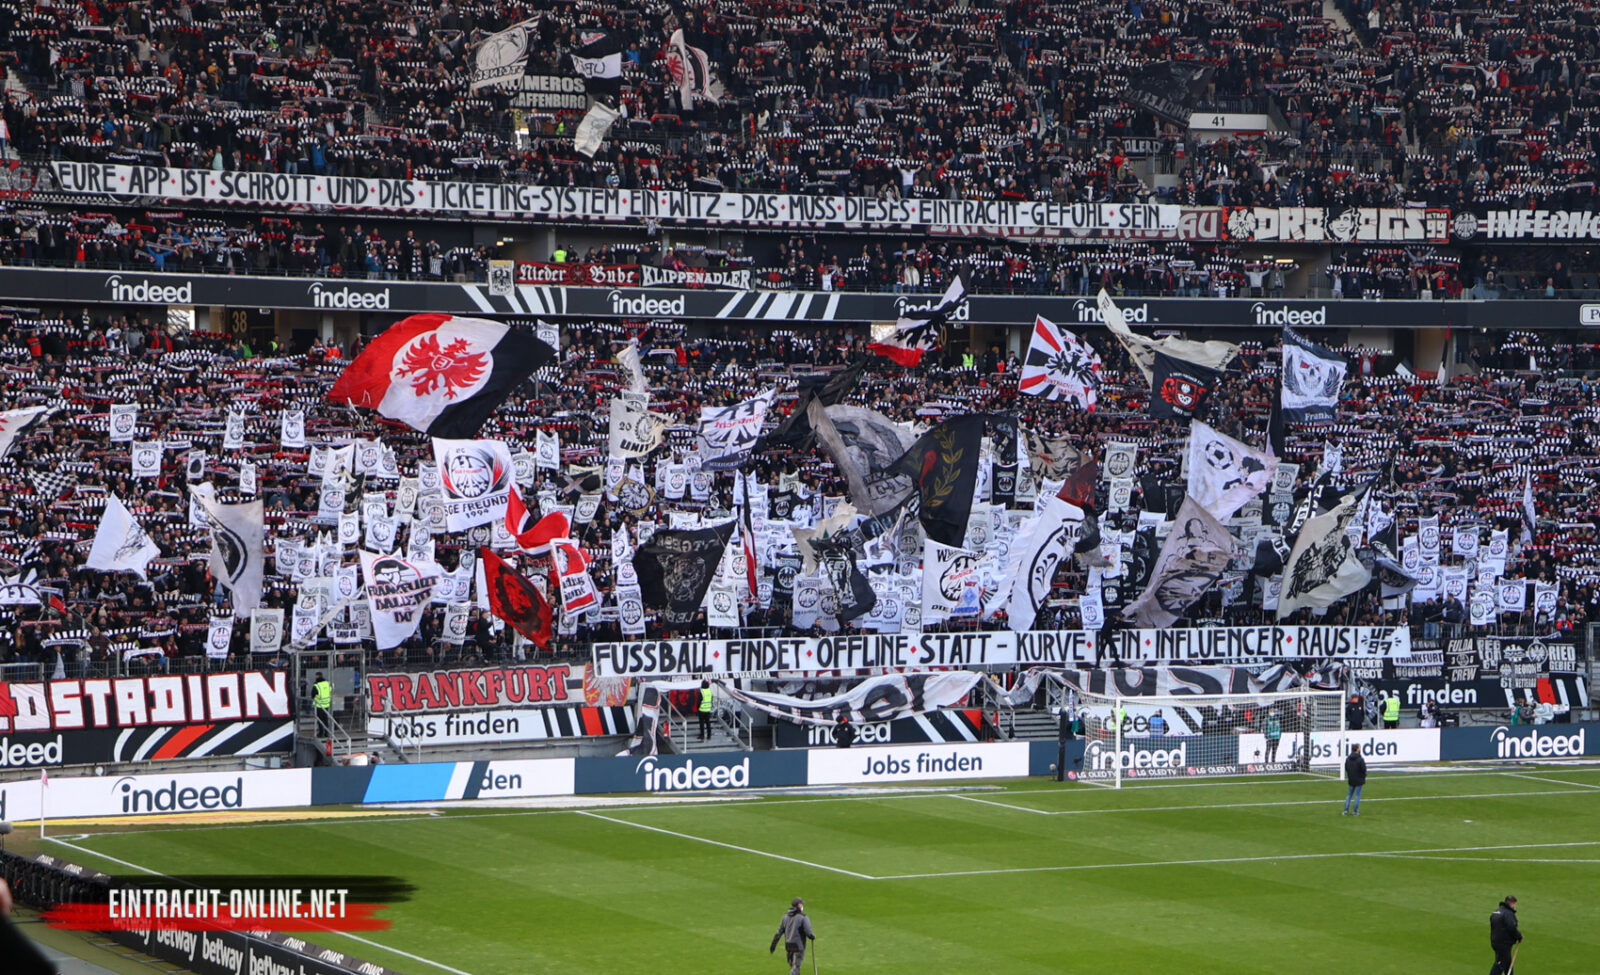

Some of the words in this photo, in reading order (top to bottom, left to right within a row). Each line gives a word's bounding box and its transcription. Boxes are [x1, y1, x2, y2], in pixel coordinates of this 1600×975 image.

[1212, 116, 1226, 127] 41
[58, 163, 117, 192] EURE
[128, 167, 168, 196] APP
[181, 170, 210, 197] IST
[219, 171, 317, 202] SCHROTT
[326, 178, 368, 205] UND
[379, 179, 415, 206] DAS
[426, 182, 620, 216] TICKETING-SYSTEM
[630, 189, 659, 215] EIN
[669, 191, 721, 217] WITZ
[742, 194, 779, 220] DAS
[787, 196, 836, 221] MUSS
[843, 197, 911, 223] DIESES
[919, 200, 1110, 229] EINTRACHT-GEFÜHL
[1427, 219, 1447, 239] 99
[641, 264, 751, 290] KLIPPENADLER
[106, 276, 192, 303] indeed
[308, 284, 390, 310] indeed
[608, 290, 685, 316] indeed
[895, 296, 970, 320] indd
[1252, 303, 1326, 326] indeed
[232, 311, 247, 333] 38
[444, 503, 460, 517] SGE
[462, 494, 509, 513] FREUND
[465, 508, 490, 519] 1994
[594, 642, 713, 675] FUSSBALL
[725, 639, 807, 671] FINDET
[816, 635, 907, 668] OFFLINE
[919, 633, 992, 664] STATT
[1016, 632, 1086, 662] KURVE
[1156, 627, 1283, 659] INFLUENCER
[1299, 627, 1359, 656] RAUS!
[1367, 640, 1393, 655] 97
[1447, 639, 1473, 652] FULDA
[1548, 645, 1577, 661] RIED
[1396, 653, 1443, 664] FRANKFURT
[1514, 664, 1537, 674] REGION
[1549, 661, 1576, 671] GEBIET
[1352, 668, 1384, 679] ERBOT
[1395, 666, 1442, 678] HOOLIGANS
[1451, 668, 1477, 681] CREW
[1500, 677, 1512, 688] 61
[367, 664, 571, 712] FRANKFURT
[1406, 683, 1477, 704] finden
[444, 710, 519, 737] finden
[1490, 726, 1585, 758] indeed
[862, 754, 911, 776] Jobs
[917, 752, 983, 774] finden
[1084, 741, 1187, 770] indeed
[636, 756, 750, 791] indeed
[1136, 769, 1147, 777] LG
[1147, 769, 1167, 777] OLED
[1207, 766, 1226, 774] OLED
[112, 776, 243, 813] indeed
[157, 920, 198, 961] betway
[202, 932, 244, 975] betway
